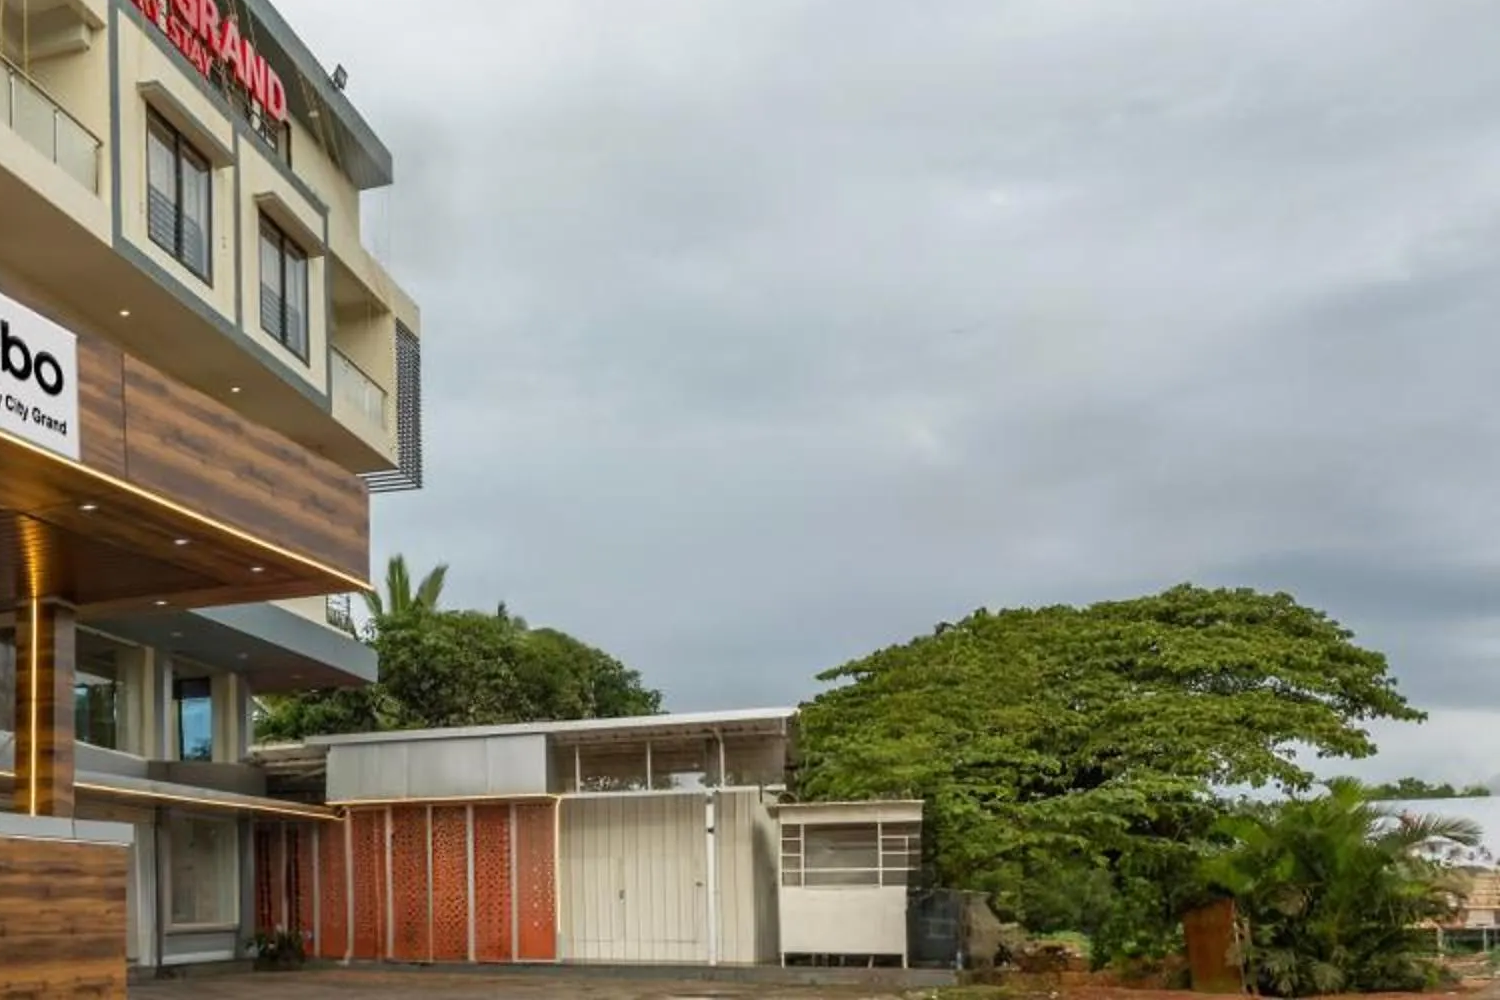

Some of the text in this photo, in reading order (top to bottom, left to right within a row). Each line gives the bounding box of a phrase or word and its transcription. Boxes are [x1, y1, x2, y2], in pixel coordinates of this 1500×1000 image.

[166, 13, 214, 79] STAY
[5, 395, 28, 421] City
[31, 407, 67, 435] Grand
